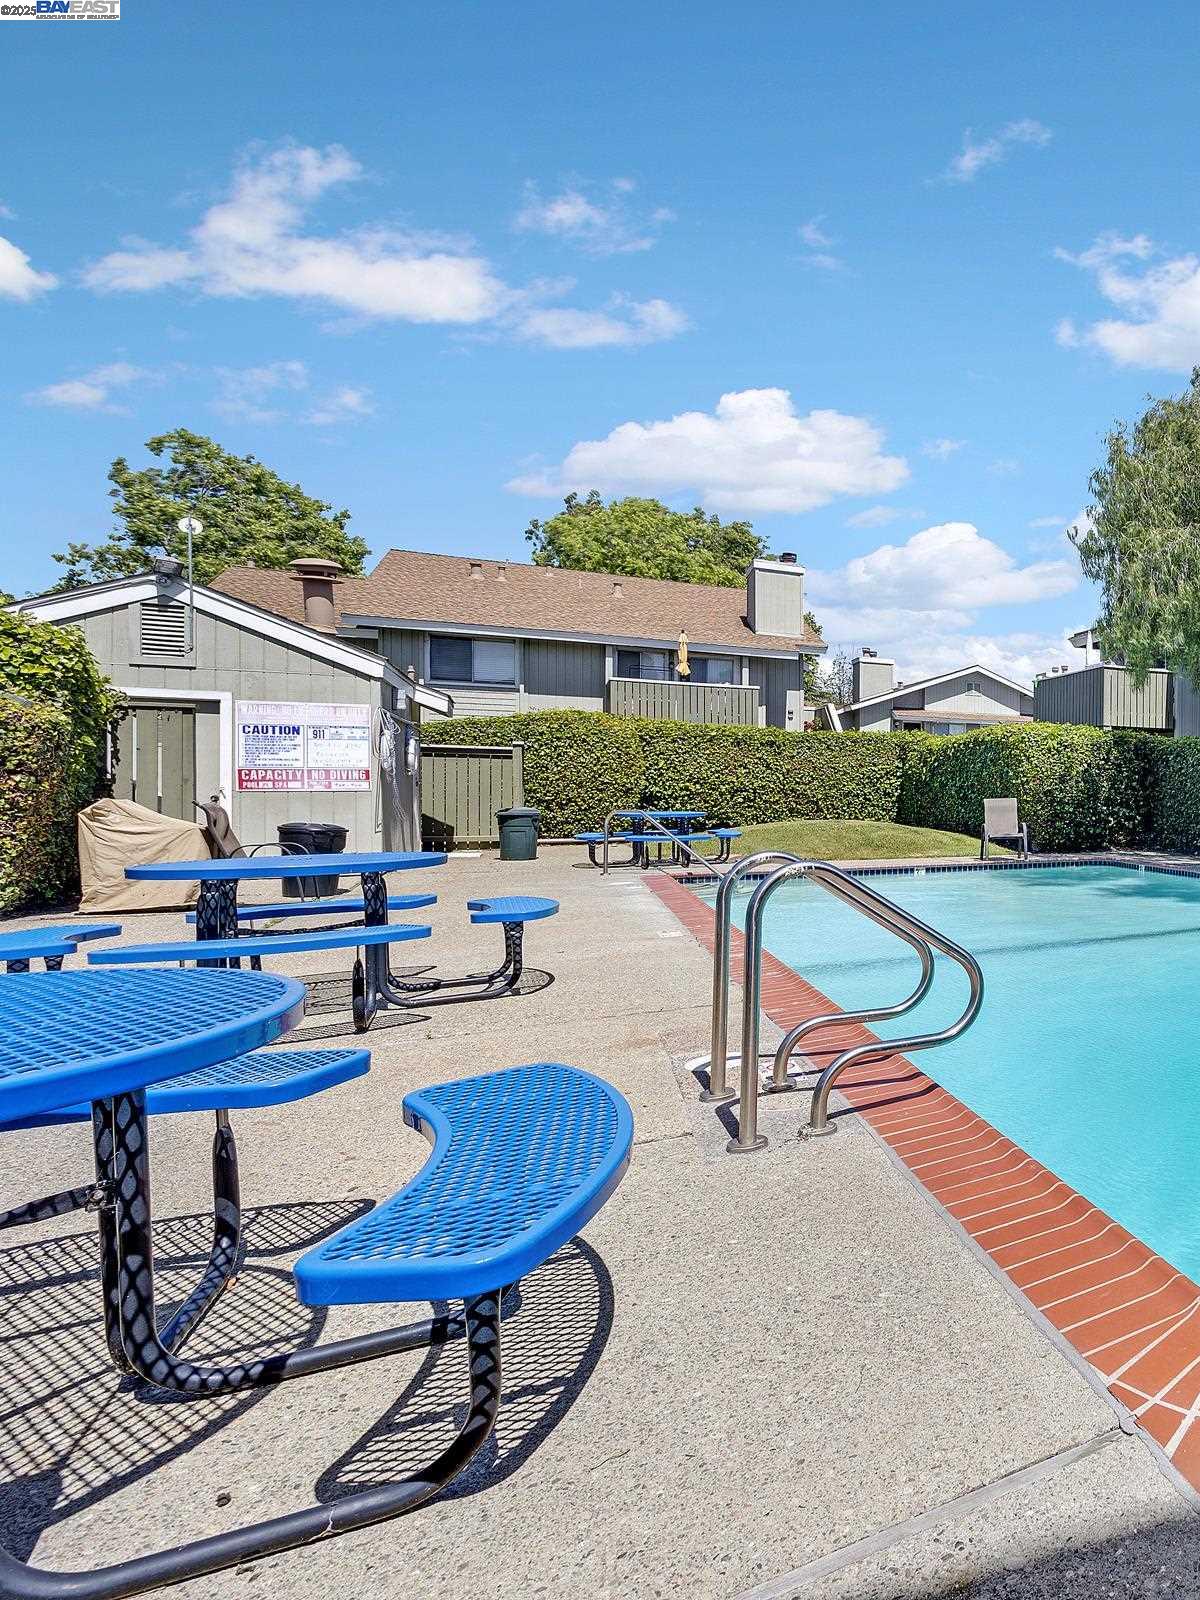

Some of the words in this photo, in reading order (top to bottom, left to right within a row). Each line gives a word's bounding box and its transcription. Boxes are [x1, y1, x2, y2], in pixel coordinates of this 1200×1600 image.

[242, 725, 301, 735] CAUTION
[312, 729, 325, 740] 911
[241, 769, 302, 780] CAPACITY
[312, 770, 326, 780] NO
[330, 770, 367, 780] DIVING
